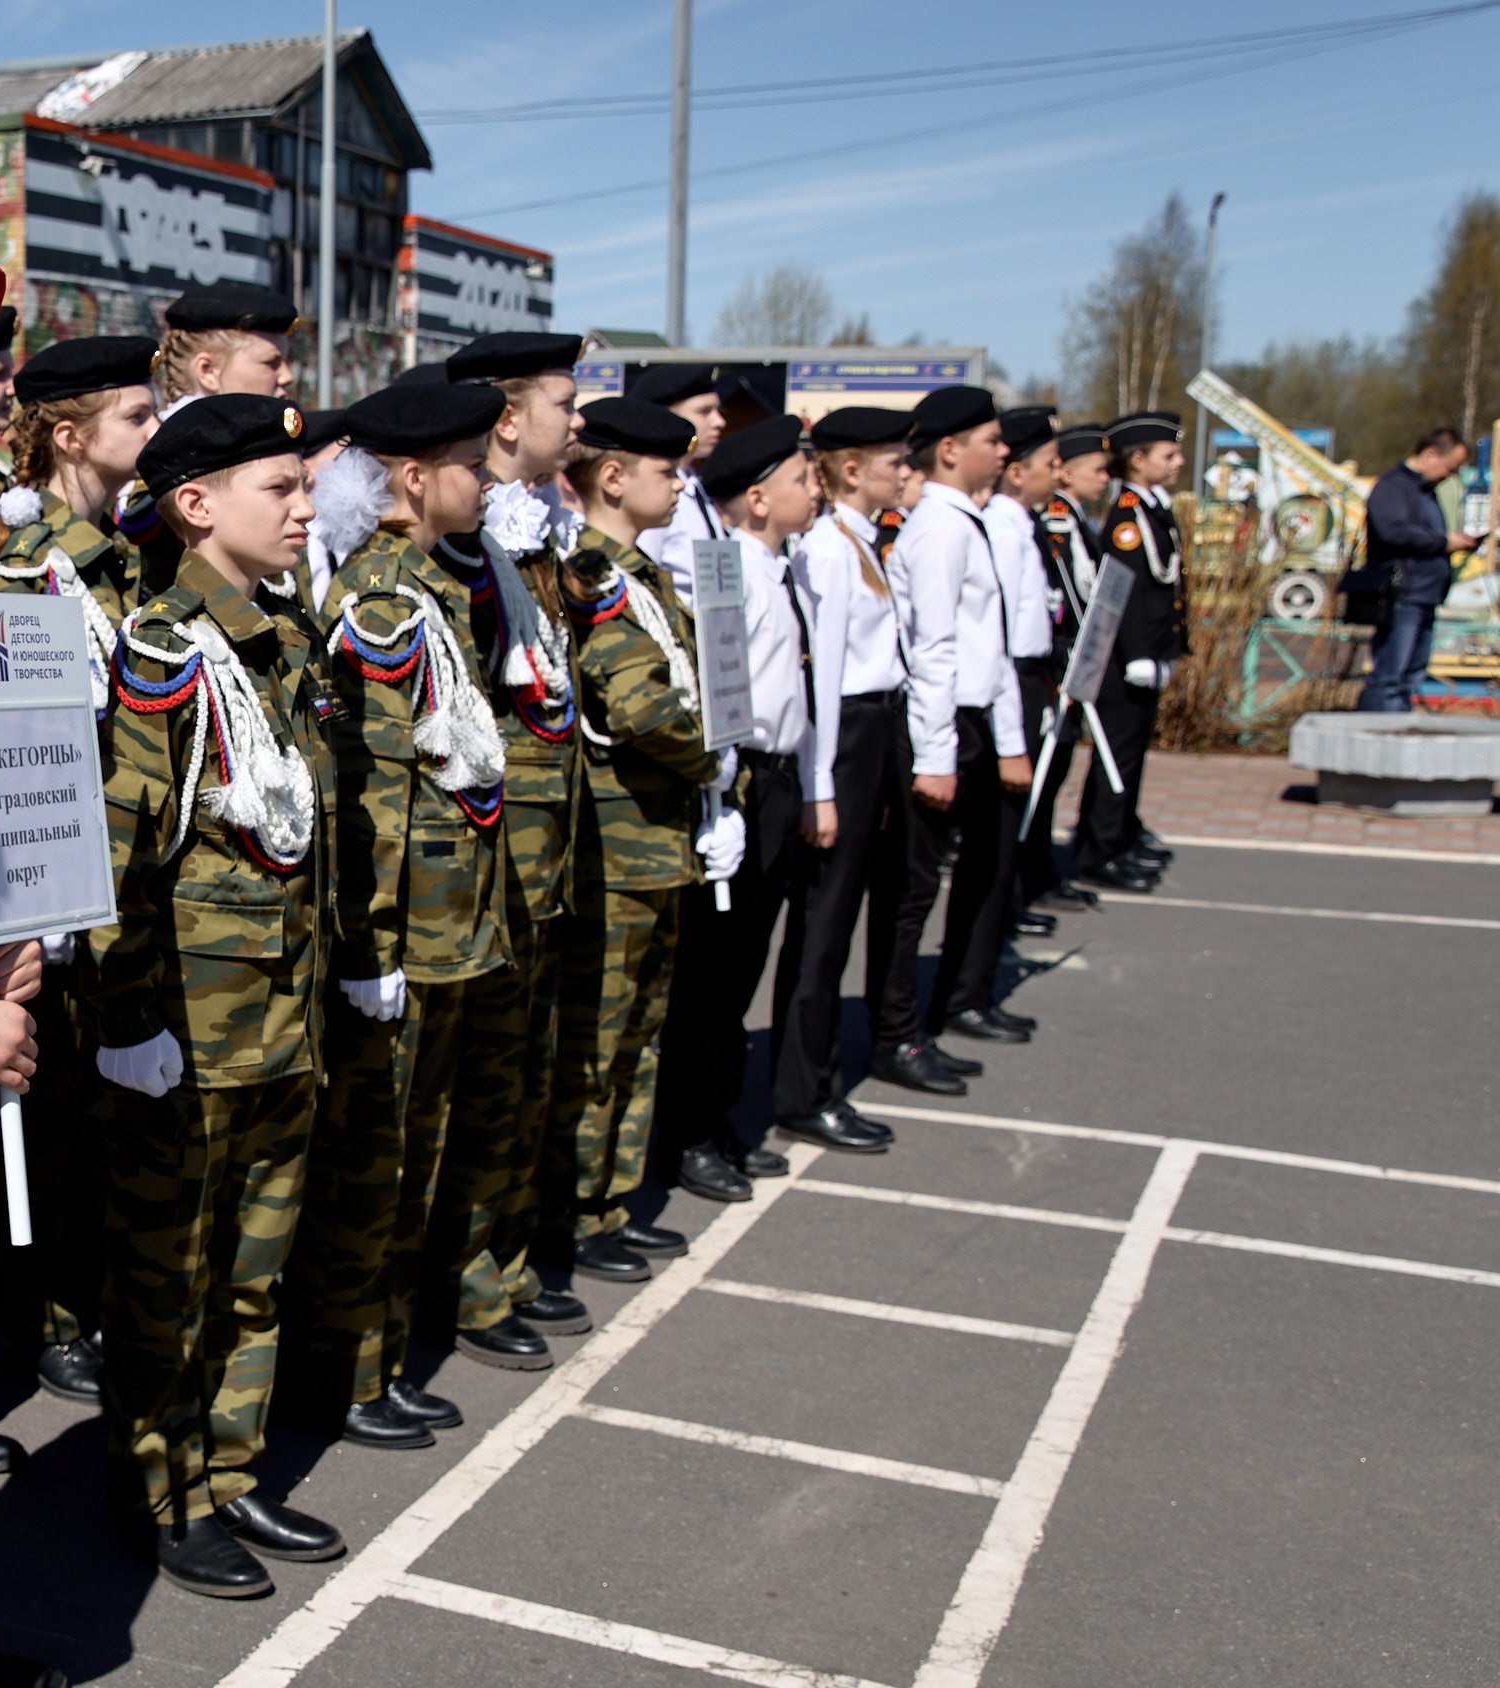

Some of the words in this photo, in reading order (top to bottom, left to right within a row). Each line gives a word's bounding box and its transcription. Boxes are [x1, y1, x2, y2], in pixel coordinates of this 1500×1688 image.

[100, 168, 226, 286] 1945
[368, 574, 382, 589] К
[9, 615, 41, 629] ДВОРЕЦ
[11, 633, 51, 646] ДЕТСКОГО
[12, 651, 19, 661] И
[20, 651, 75, 661] ЮНОШЕСКОГО
[14, 668, 64, 679] ТВОРЧЕСТВА
[7, 864, 48, 887] округ
